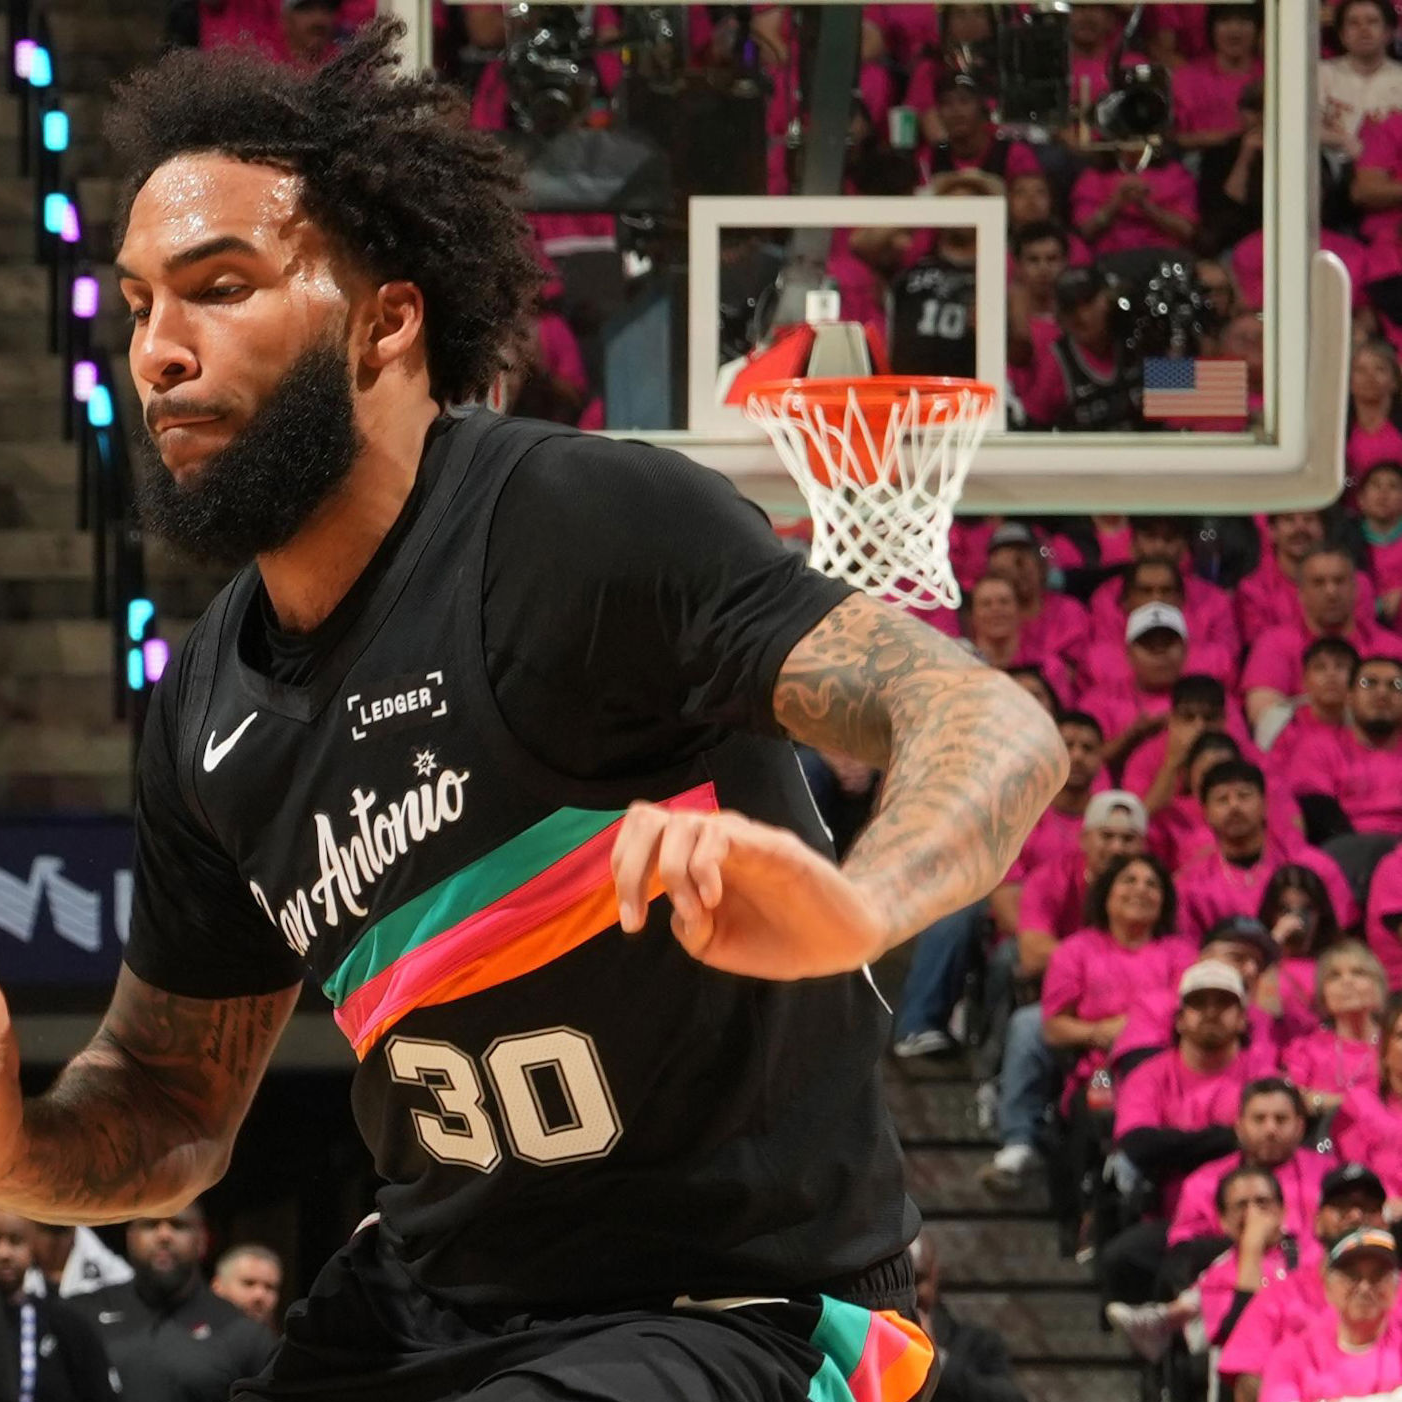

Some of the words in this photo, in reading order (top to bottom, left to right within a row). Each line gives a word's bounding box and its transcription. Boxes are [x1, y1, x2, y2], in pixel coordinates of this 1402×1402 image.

[360, 687, 433, 726] LEDGER
[310, 749, 471, 927] Antonio
[384, 1025, 624, 1175] 30
